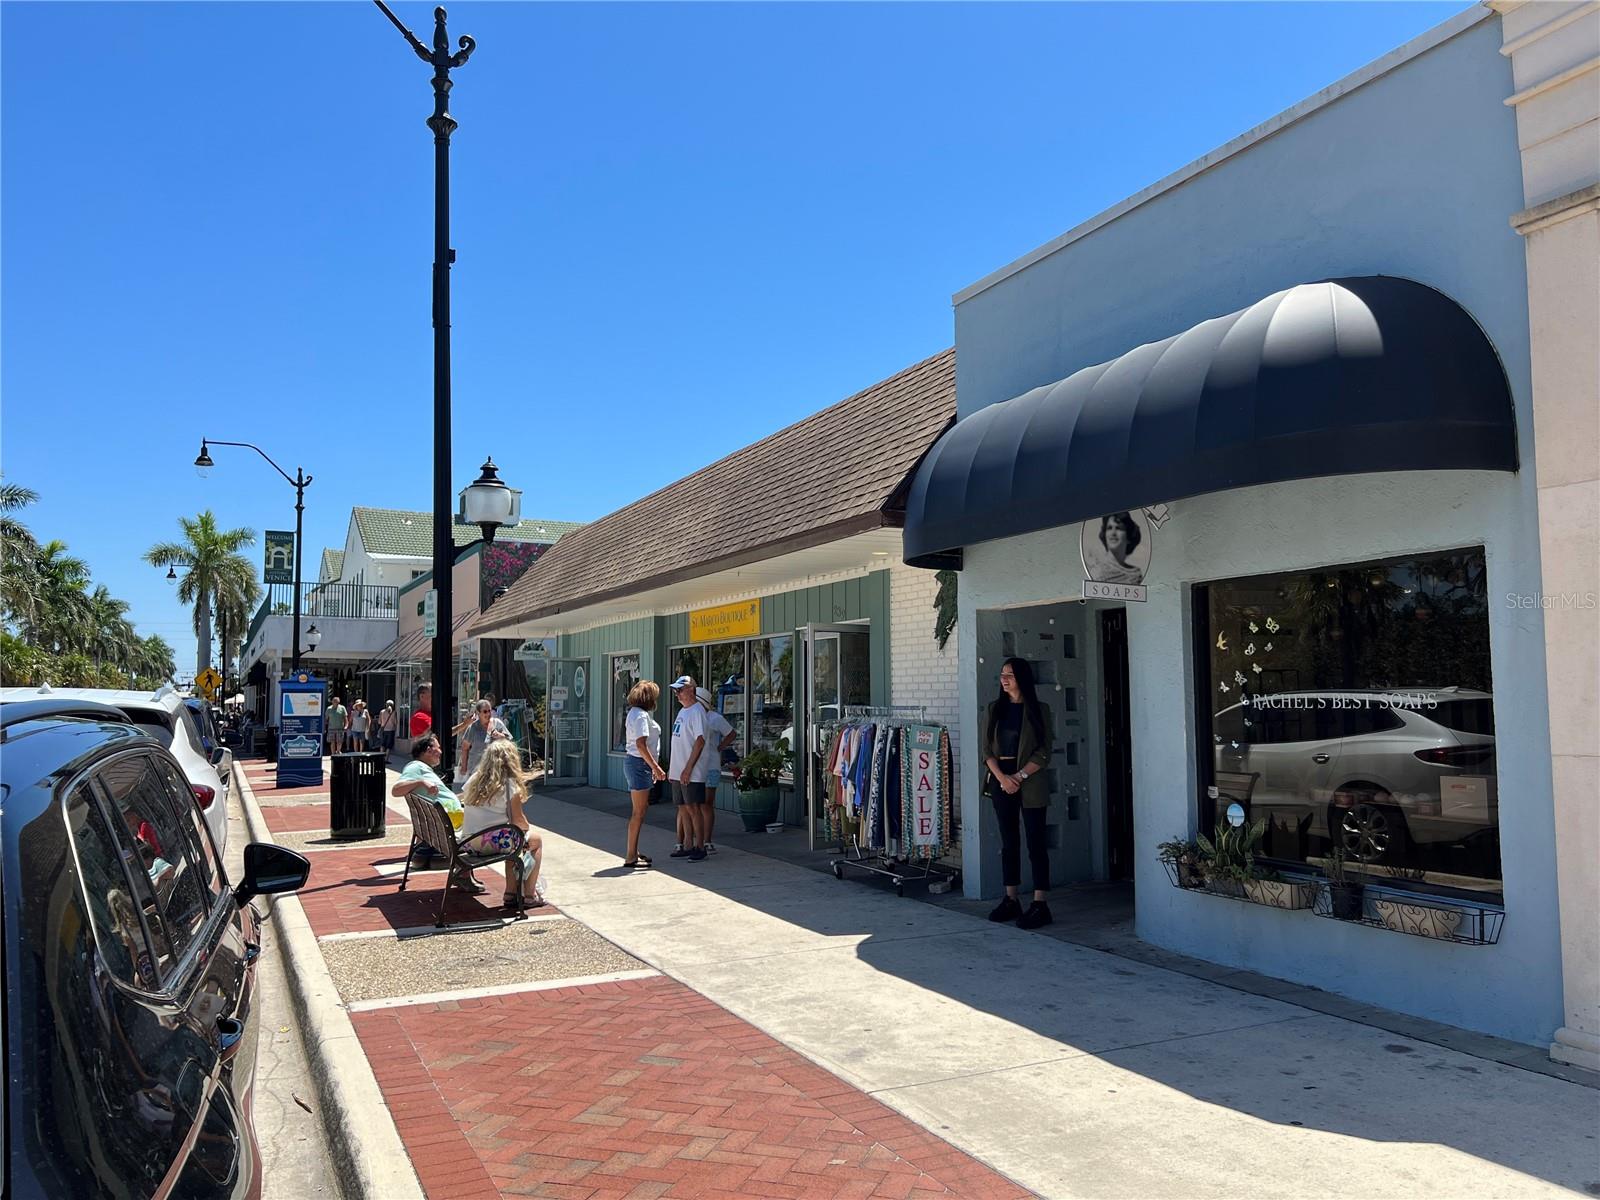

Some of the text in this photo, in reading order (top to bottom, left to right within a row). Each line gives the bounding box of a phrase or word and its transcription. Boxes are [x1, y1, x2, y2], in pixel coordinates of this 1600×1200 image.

[1092, 584, 1140, 599] SOAPS
[1252, 692, 1438, 710] RACHELS BEST SOAPS
[917, 751, 933, 836] SALE
